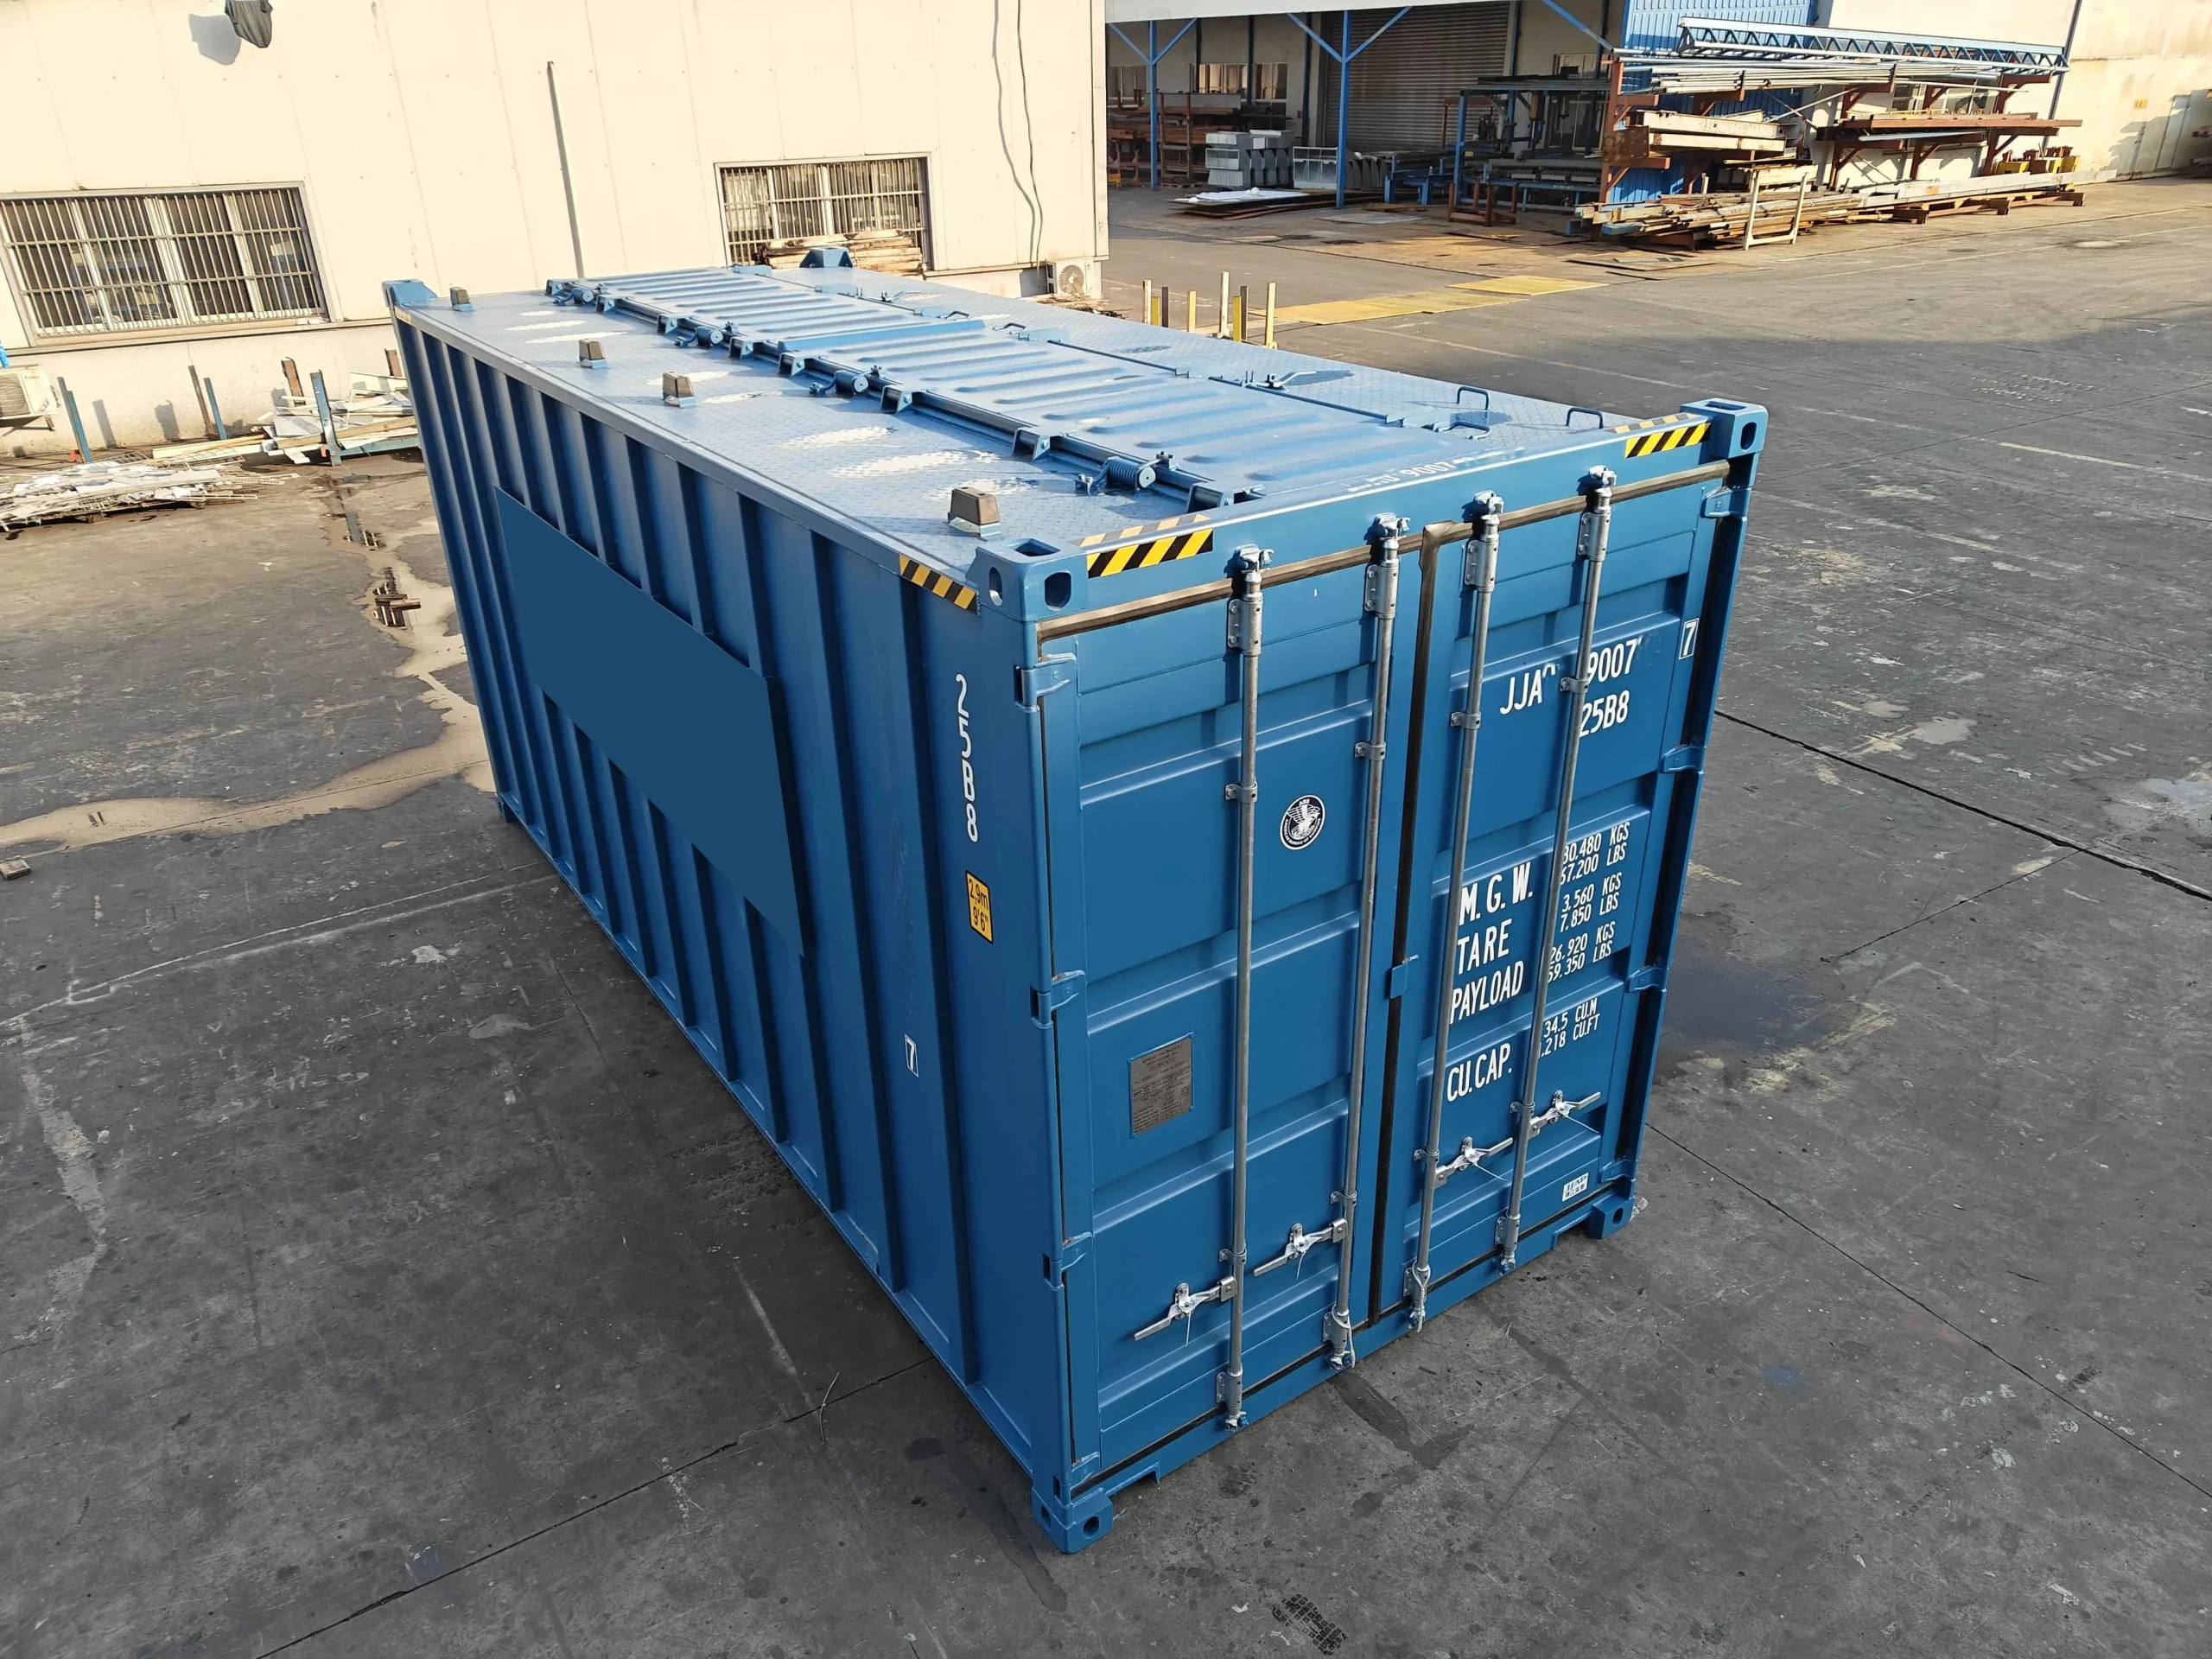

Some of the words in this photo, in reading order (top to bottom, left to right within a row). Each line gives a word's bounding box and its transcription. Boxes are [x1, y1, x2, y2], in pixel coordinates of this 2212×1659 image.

[1683, 620, 1697, 656] 7
[1580, 690, 1630, 737] 25B8
[956, 673, 978, 842] 25B8
[1610, 822, 1630, 846] KGS
[1606, 842, 1627, 866] LBS
[1602, 872, 1623, 896] KGS
[1599, 892, 1619, 916] LBS
[1458, 918, 1512, 975] TARE
[1596, 921, 1616, 945] KGS
[1592, 940, 1613, 963] LBS
[1450, 960, 1524, 1025] PAYLOAD
[1543, 1011, 1568, 1039] 34.5
[1573, 1013, 1600, 1040] CU.FT
